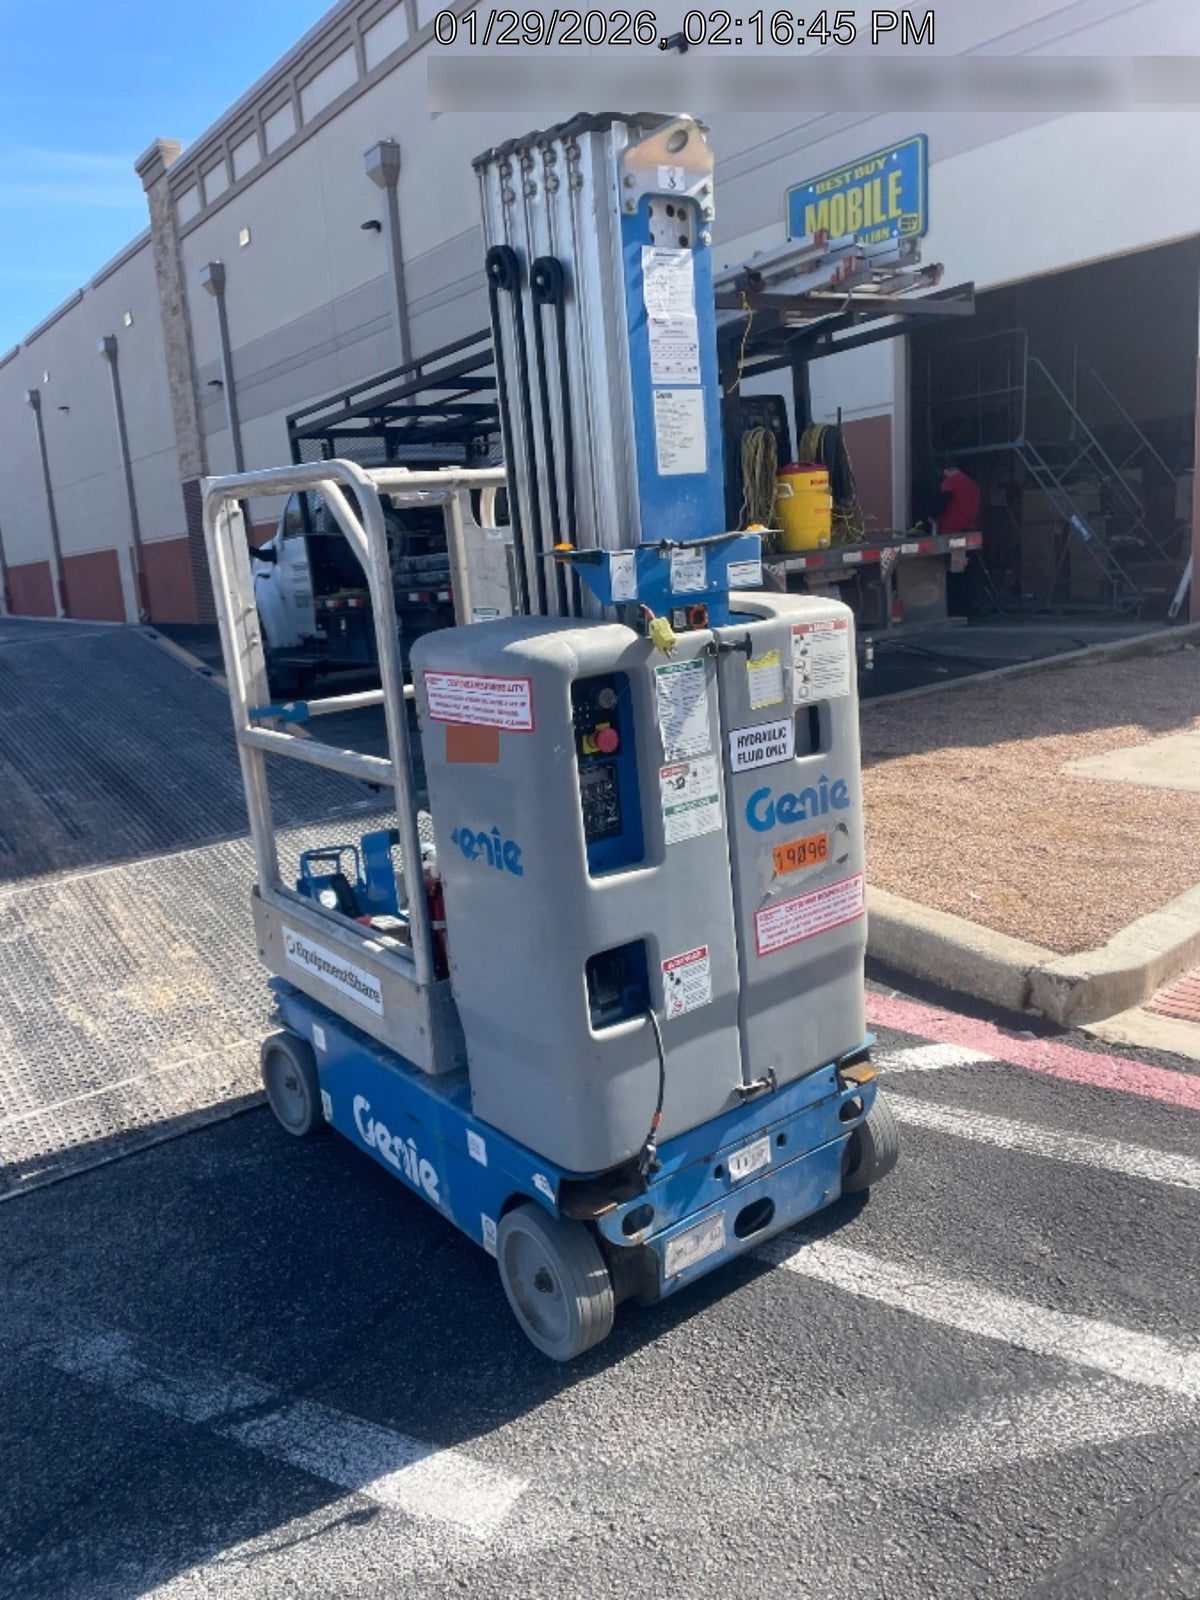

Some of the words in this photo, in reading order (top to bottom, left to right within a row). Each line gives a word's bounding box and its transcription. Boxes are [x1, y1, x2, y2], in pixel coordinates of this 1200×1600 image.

[815, 171, 851, 195] BEST
[854, 155, 888, 180] BUY
[805, 170, 903, 239] MOBILE
[737, 726, 787, 749] HYDRAULIC
[737, 748, 764, 765] FLUID
[765, 742, 788, 759] ONLY
[745, 774, 850, 832] Genie
[296, 941, 381, 1004] EquipmentShare
[352, 1094, 441, 1205] Genie
